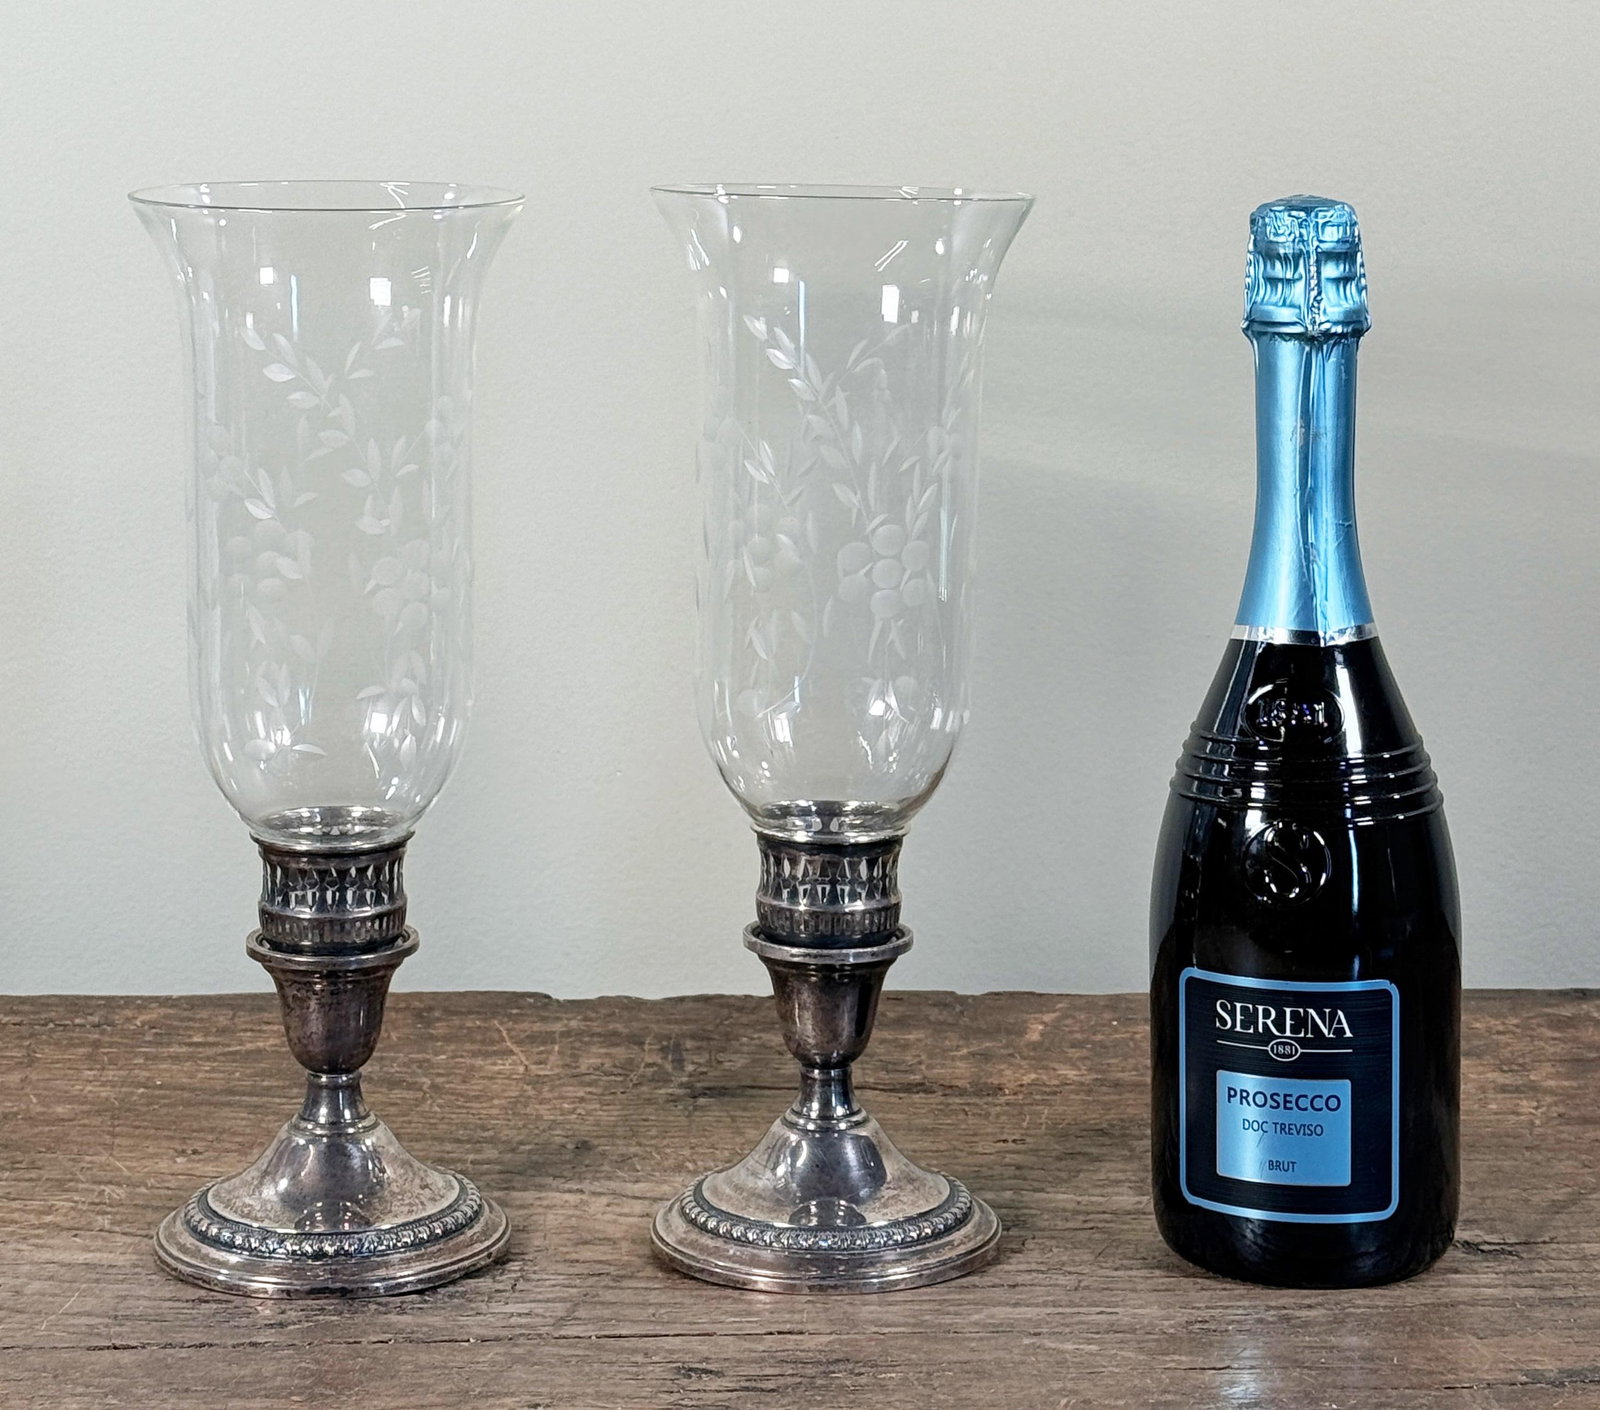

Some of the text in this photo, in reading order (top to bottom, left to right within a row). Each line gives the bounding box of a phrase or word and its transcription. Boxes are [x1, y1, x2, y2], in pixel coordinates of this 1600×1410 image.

[1216, 999, 1353, 1038] SERENA
[1273, 1044, 1296, 1055] 1881
[1227, 1086, 1341, 1112] PROSECCO
[1242, 1118, 1324, 1137] DOC TREVISO
[1268, 1160, 1296, 1173] BRUT
